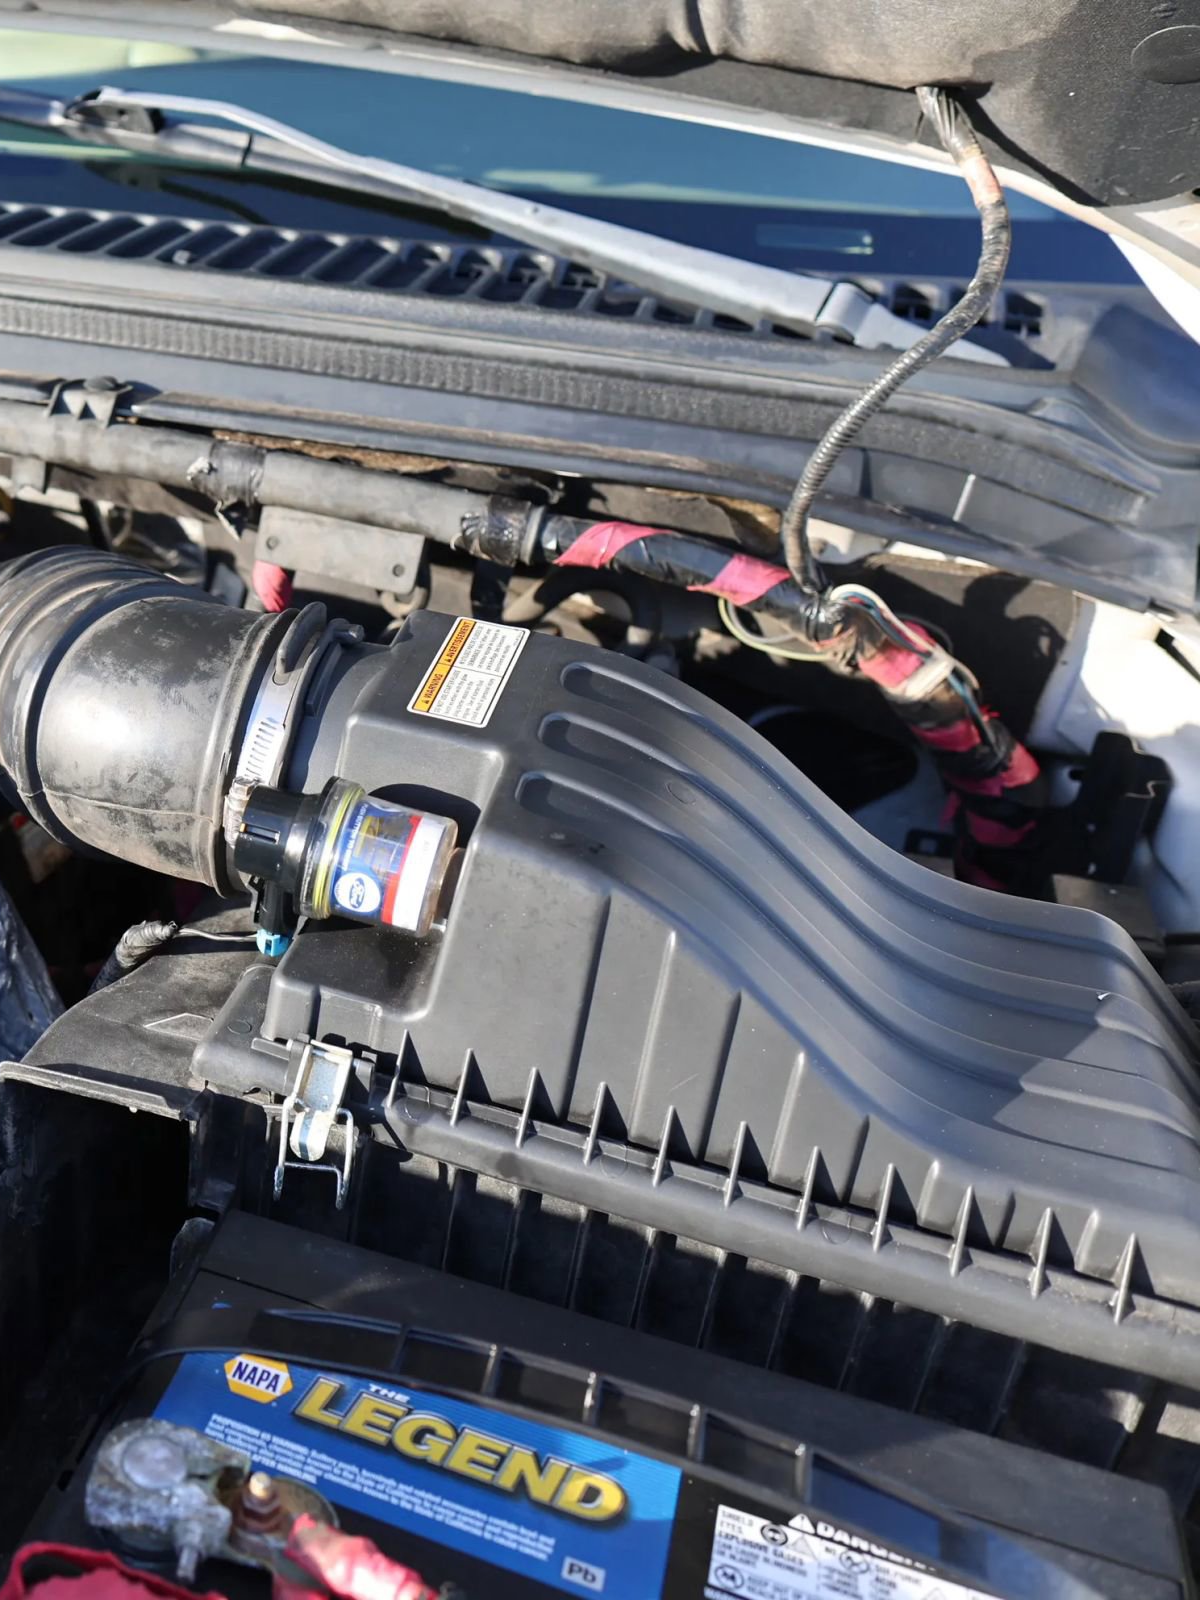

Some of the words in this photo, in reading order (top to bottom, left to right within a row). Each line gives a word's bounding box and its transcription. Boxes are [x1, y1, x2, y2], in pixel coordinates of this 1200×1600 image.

[449, 621, 471, 658] AVERTISSEMENT
[423, 674, 443, 698] WARNING
[349, 878, 366, 909] Ford
[231, 1360, 281, 1392] NAPA
[369, 1383, 410, 1402] THE
[294, 1375, 628, 1521] LEGEND
[567, 1561, 597, 1584] Pb
